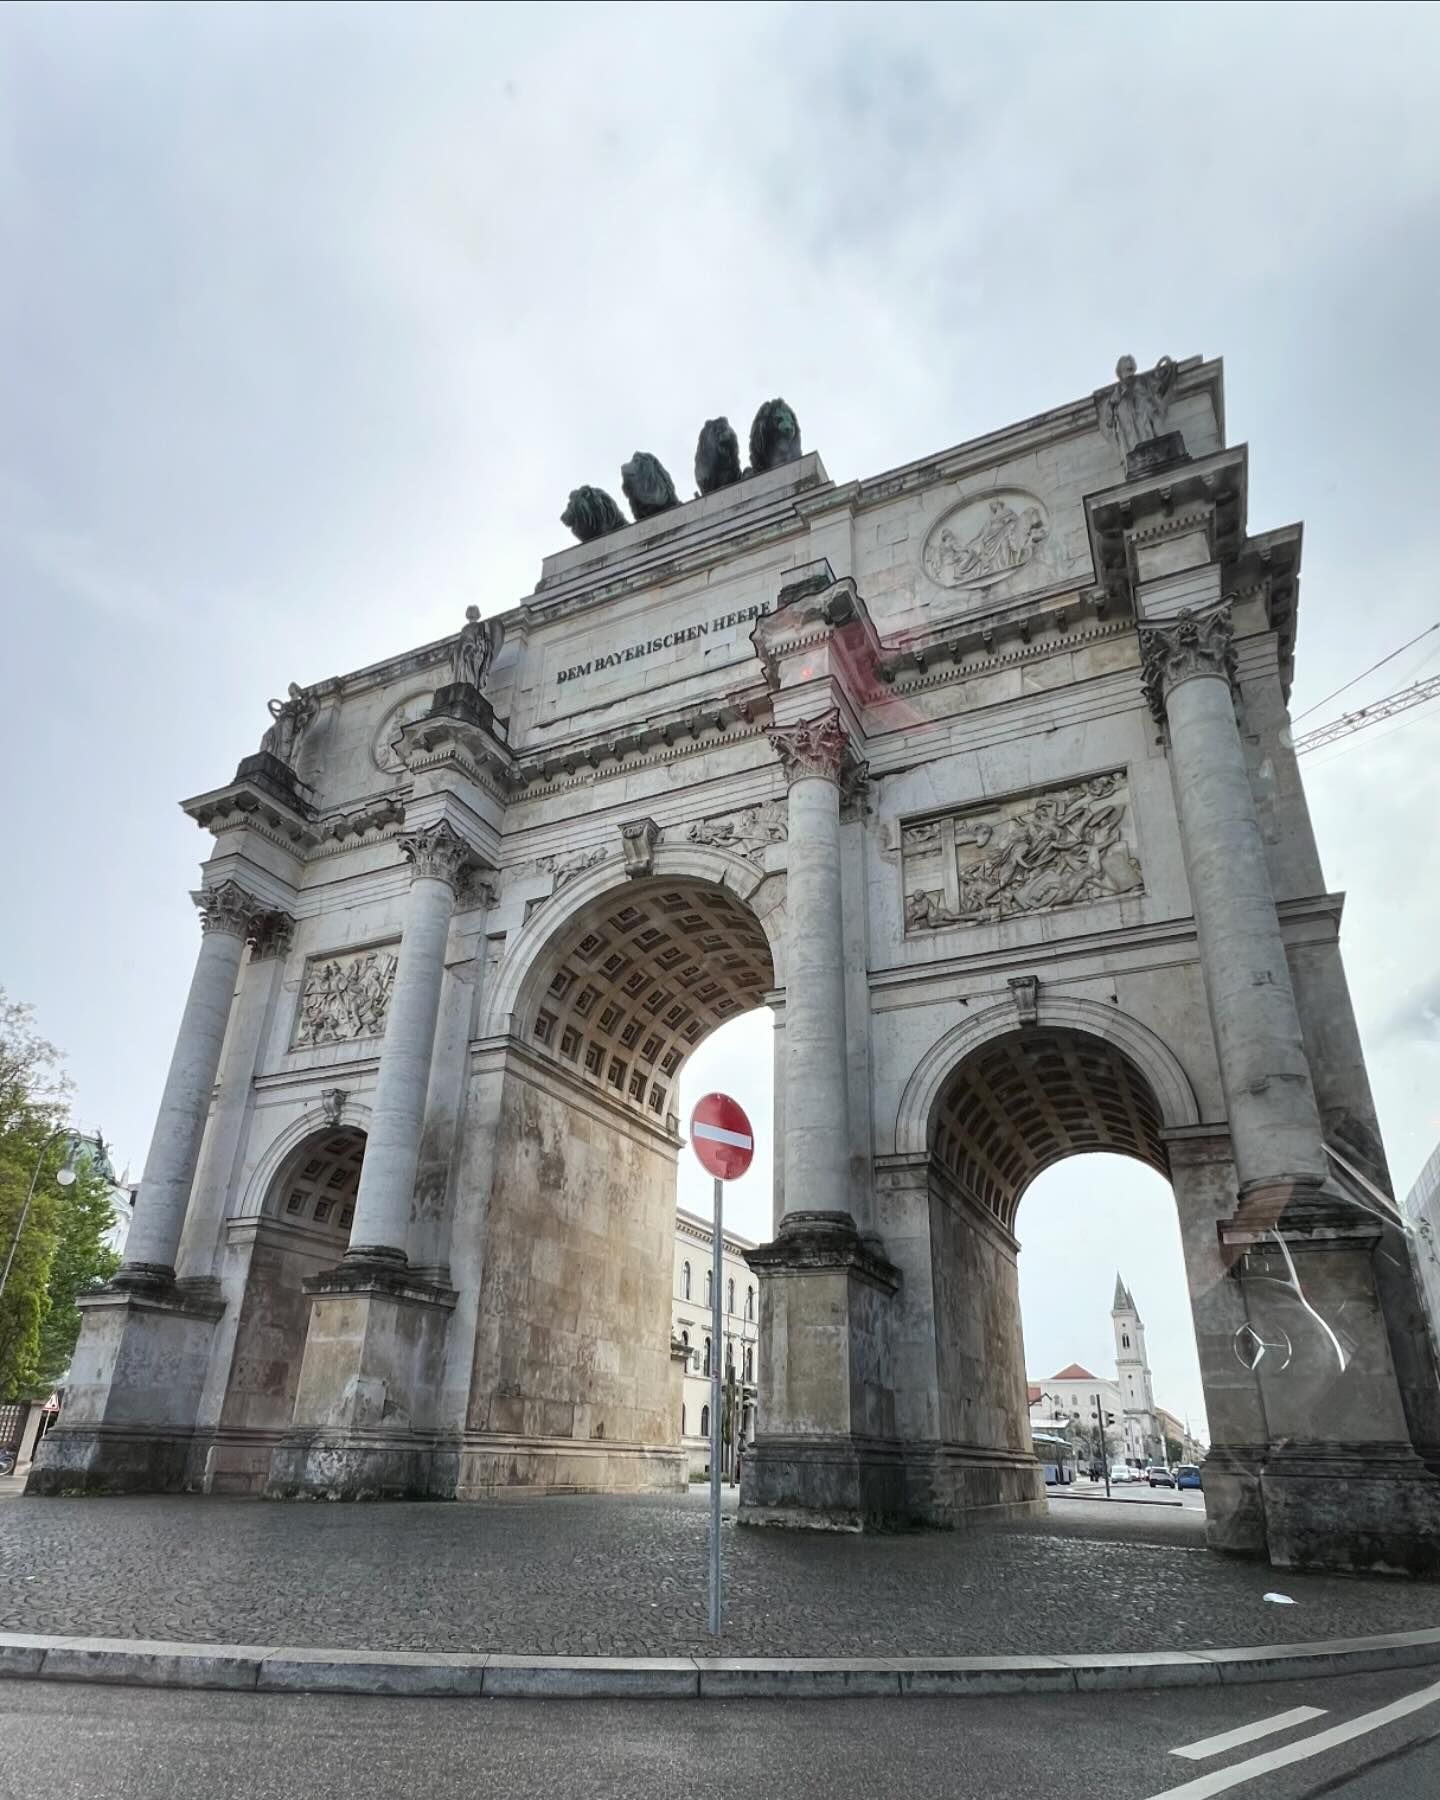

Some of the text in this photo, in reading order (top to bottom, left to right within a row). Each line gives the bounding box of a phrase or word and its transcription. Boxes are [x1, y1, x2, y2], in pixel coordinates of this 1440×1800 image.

[556, 600, 771, 685] DEM BAYERISCHEN HEERE
